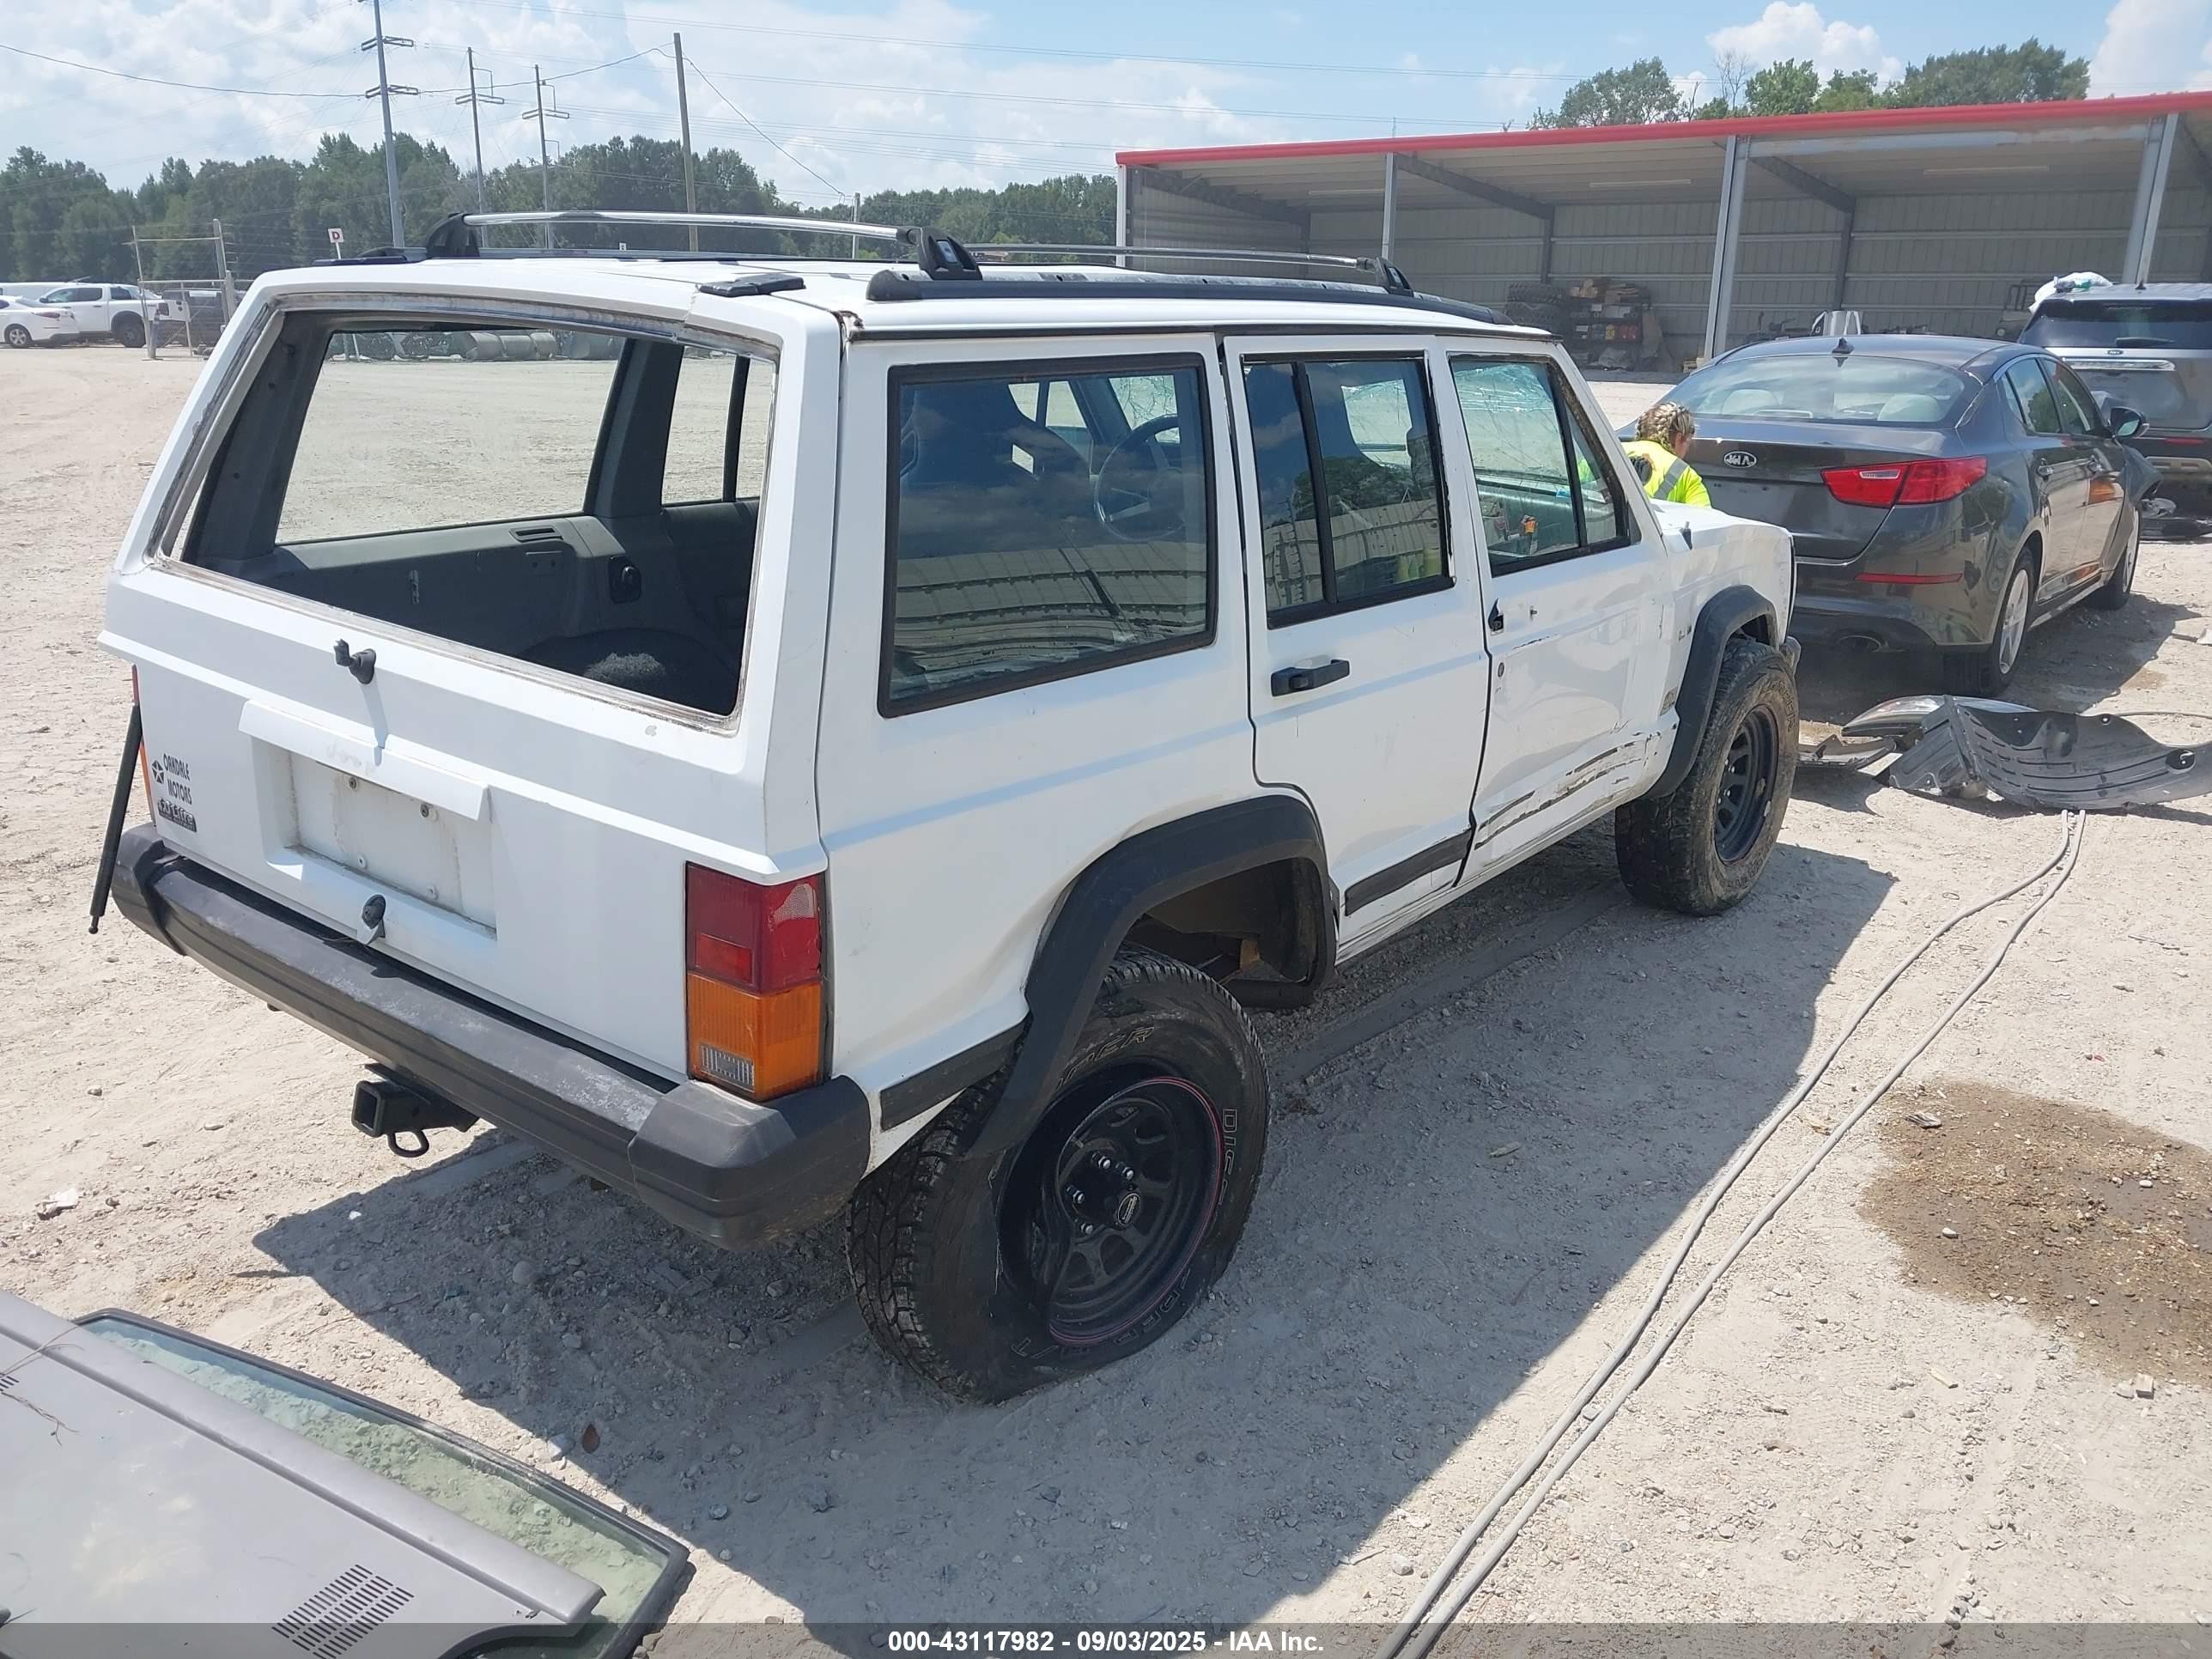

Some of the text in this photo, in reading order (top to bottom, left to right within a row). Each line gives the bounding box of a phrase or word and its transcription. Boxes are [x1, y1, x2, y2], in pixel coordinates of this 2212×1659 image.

[1727, 453, 1753, 466] KIA
[163, 753, 191, 781] OAKDALE
[167, 778, 192, 805] MOTORS
